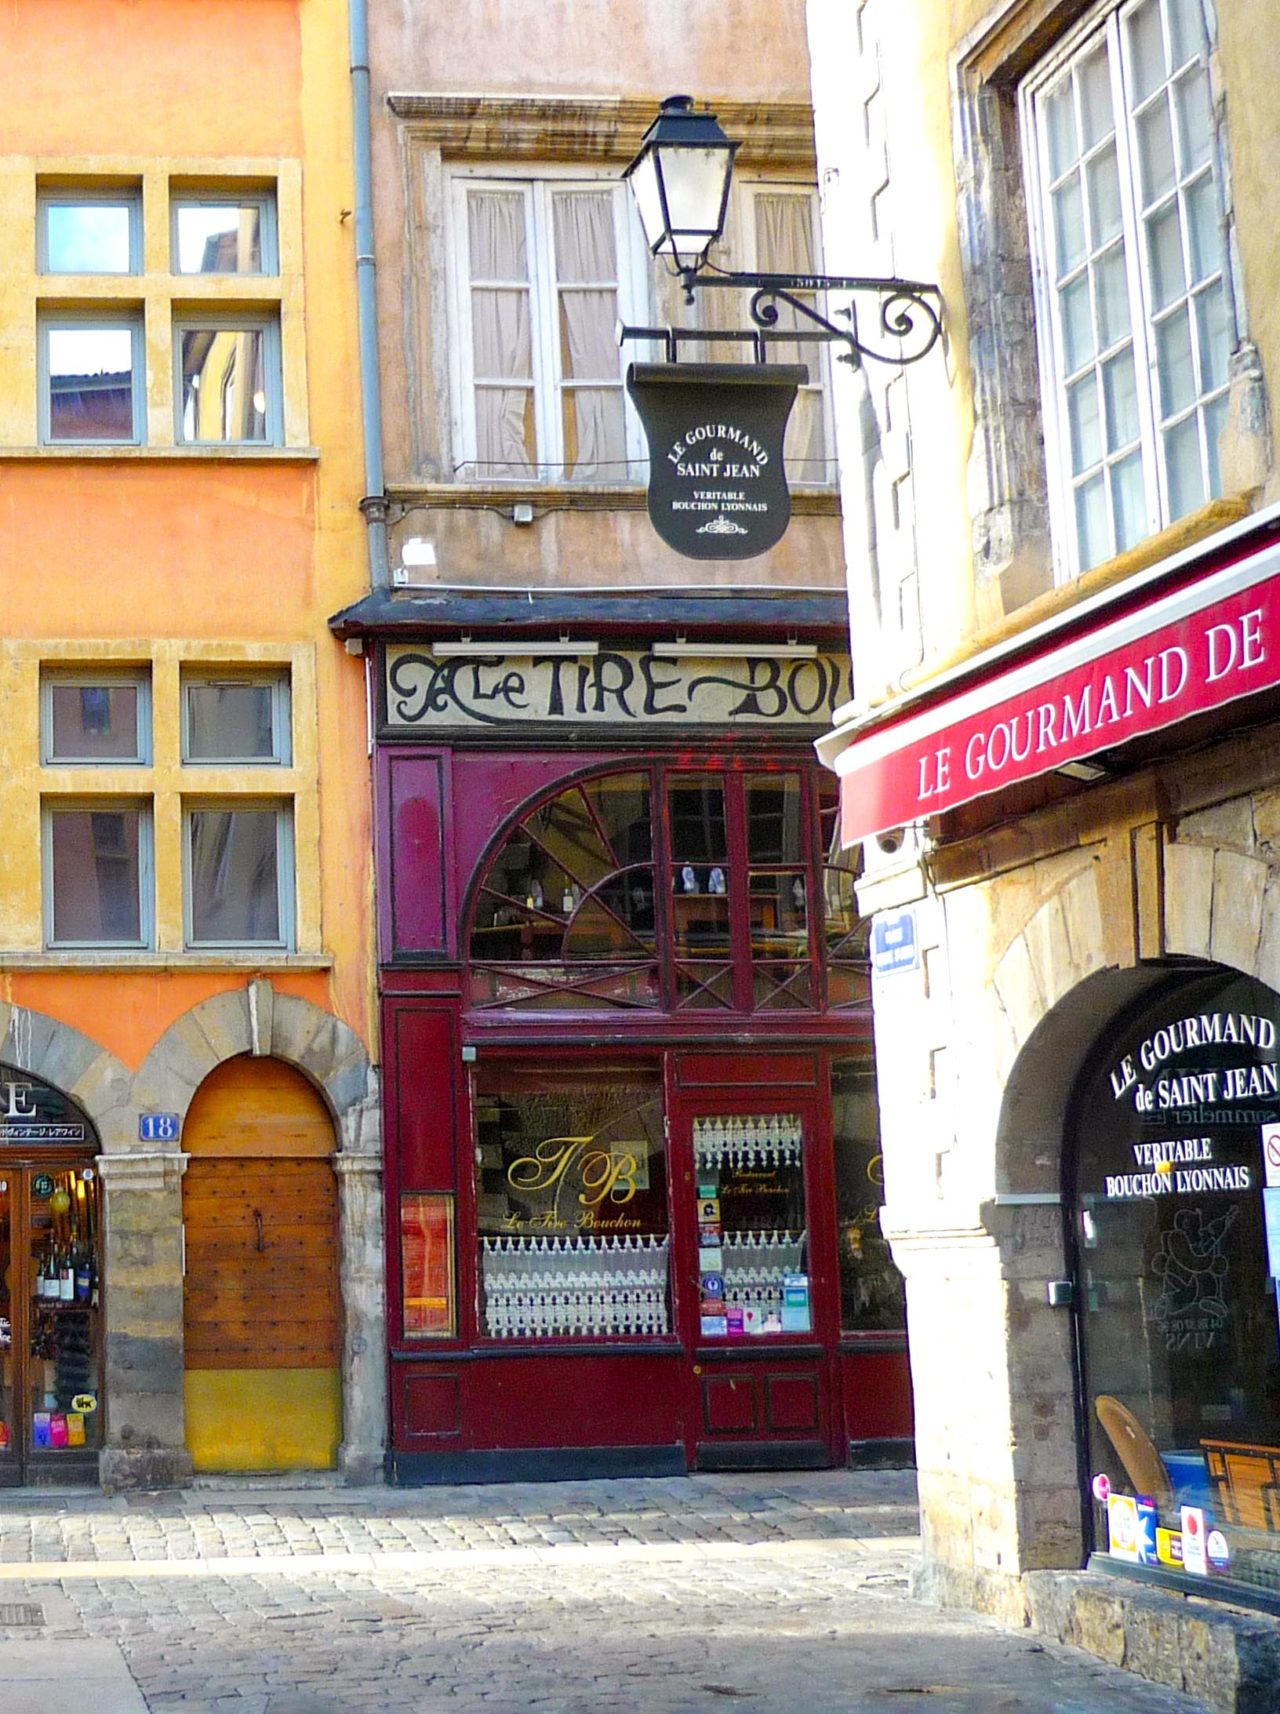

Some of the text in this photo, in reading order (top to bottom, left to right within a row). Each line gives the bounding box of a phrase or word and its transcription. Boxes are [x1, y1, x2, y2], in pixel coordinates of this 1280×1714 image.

[667, 424, 769, 466] LE GOURMAND
[710, 448, 724, 461] de
[677, 463, 761, 477] SAINT JEAN
[672, 501, 768, 511] BOUCHON LYONNAIS
[693, 491, 746, 500] VERITABLE
[916, 608, 1266, 801] LE GOURMAND DE
[1109, 1013, 1276, 1100] LE GOURMAND
[1135, 1062, 1279, 1113] de SAINT JEAN
[146, 1116, 173, 1138] 18
[1133, 1137, 1212, 1166] VERITABLE
[1105, 1165, 1250, 1198] BOUCHON LYONNAIS
[503, 1212, 525, 1229] Le
[575, 1211, 642, 1229] Bouchon
